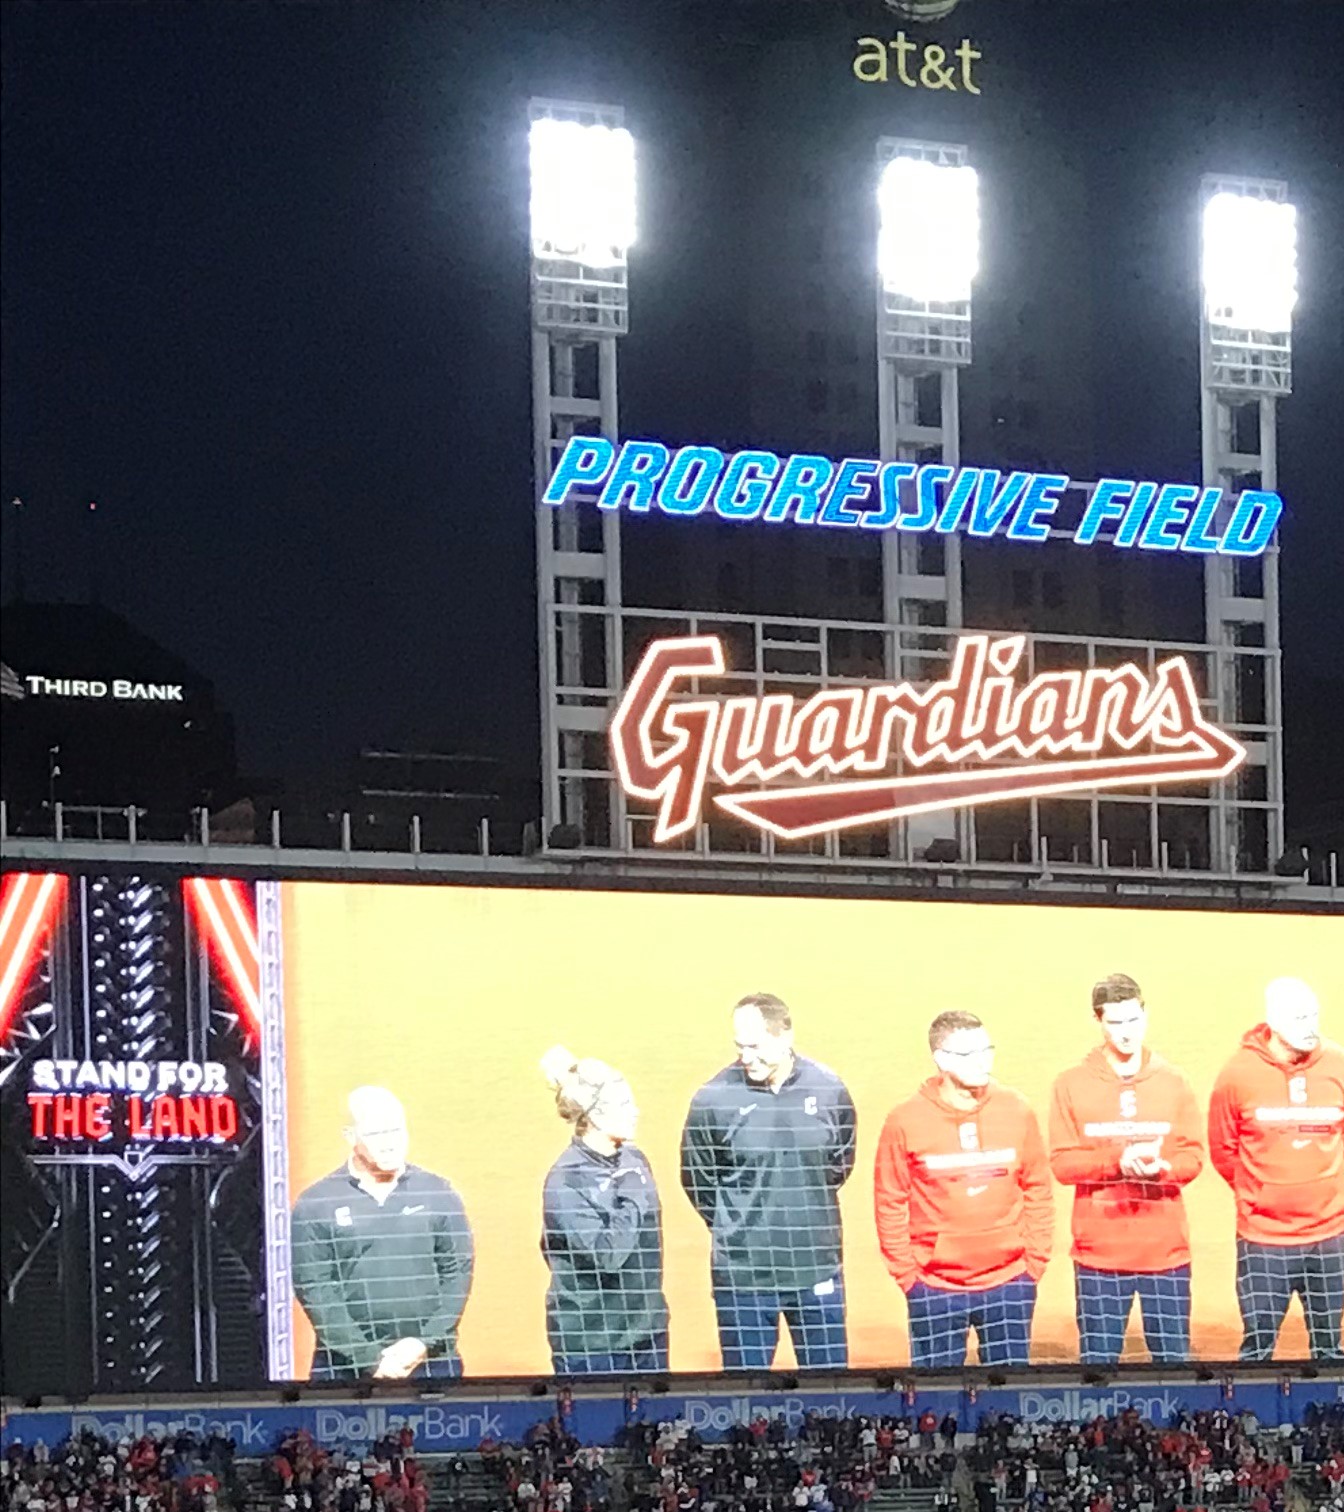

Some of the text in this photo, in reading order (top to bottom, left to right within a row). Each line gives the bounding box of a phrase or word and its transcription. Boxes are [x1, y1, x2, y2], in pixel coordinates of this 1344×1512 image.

[853, 31, 982, 96] at&t
[543, 436, 1286, 558] PROGRESSIVE FIELD
[26, 675, 183, 701] THIRD BANK
[610, 635, 1246, 843] Guardians
[33, 1060, 229, 1092] STAND FOR
[28, 1093, 237, 1143] THE LAND
